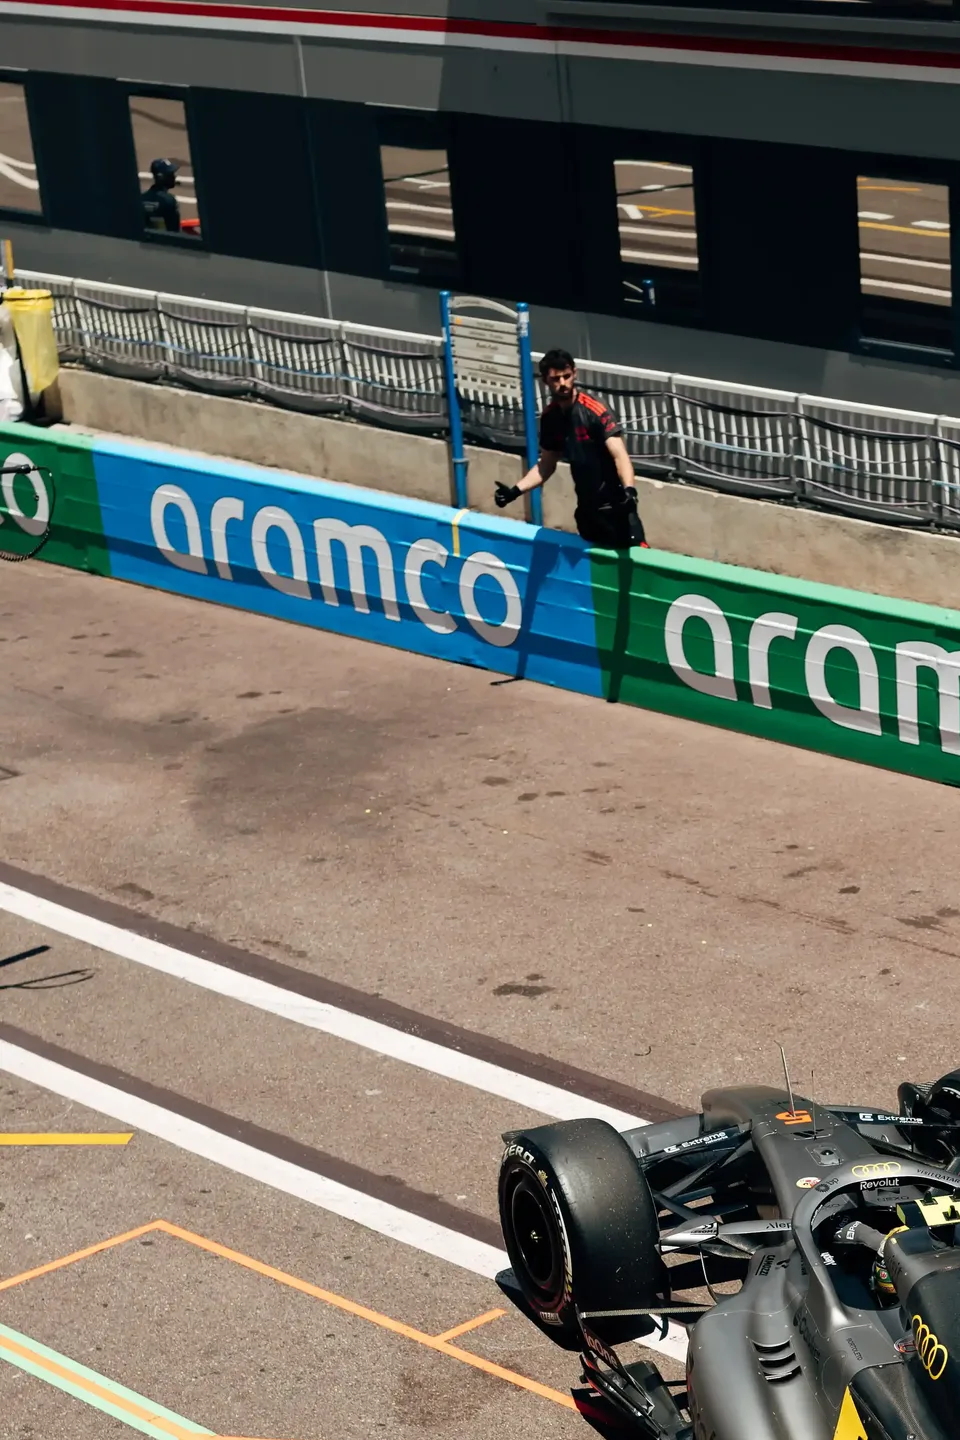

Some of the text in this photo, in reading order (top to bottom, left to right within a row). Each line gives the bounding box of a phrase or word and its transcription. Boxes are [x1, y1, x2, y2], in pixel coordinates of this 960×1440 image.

[152, 485, 522, 647] aramco
[878, 1114, 923, 1122] Extreme
[681, 1131, 727, 1148] Extreme
[827, 1177, 840, 1188] bp
[859, 1177, 900, 1191] Revolut
[846, 1337, 864, 1362] BORTOLETO
